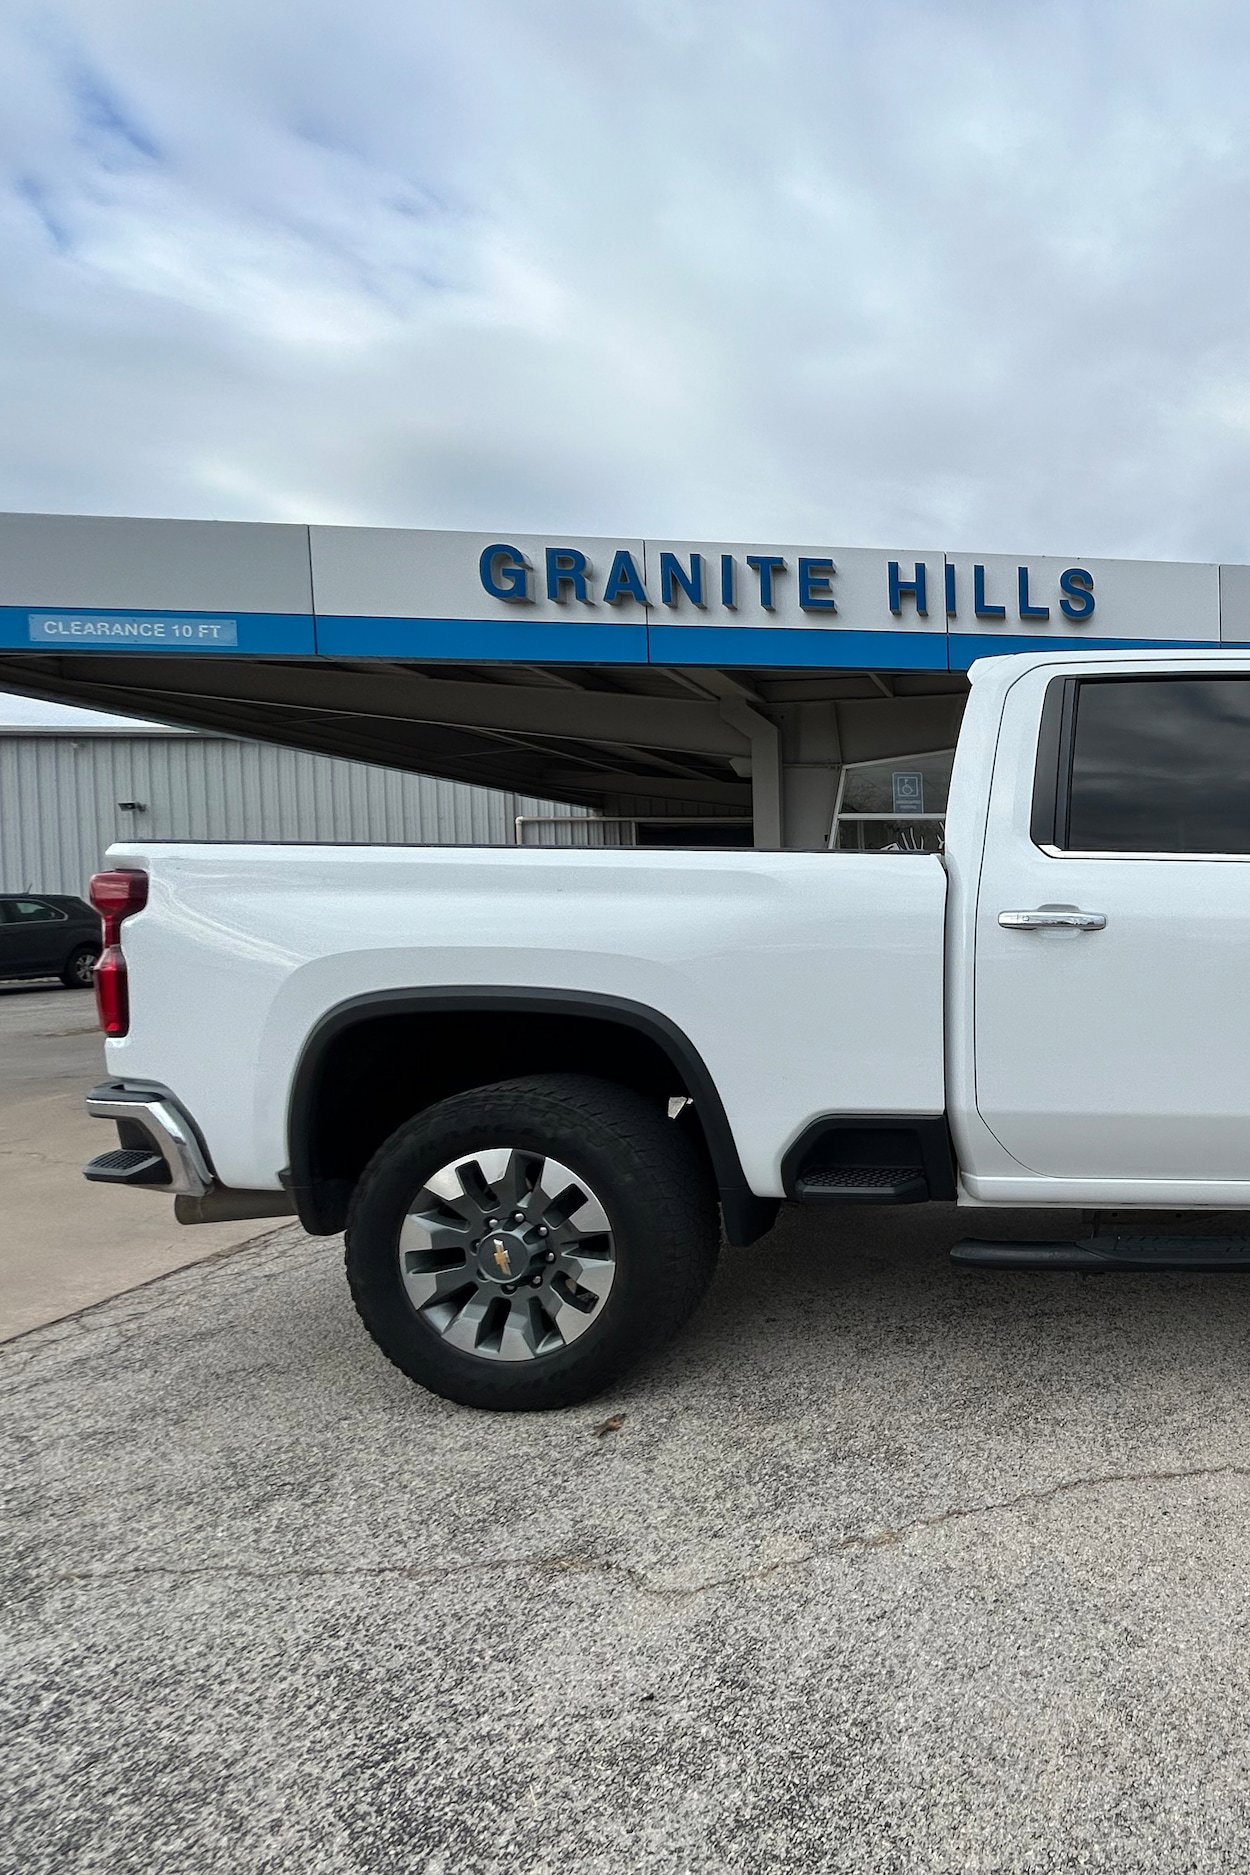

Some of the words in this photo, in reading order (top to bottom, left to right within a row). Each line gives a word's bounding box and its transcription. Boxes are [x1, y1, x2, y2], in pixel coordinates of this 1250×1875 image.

[479, 543, 837, 613] GRANITE
[888, 561, 1096, 619] HILLS
[44, 621, 166, 637] CLEARANCE
[172, 625, 193, 638] 10
[198, 625, 221, 638] FT
